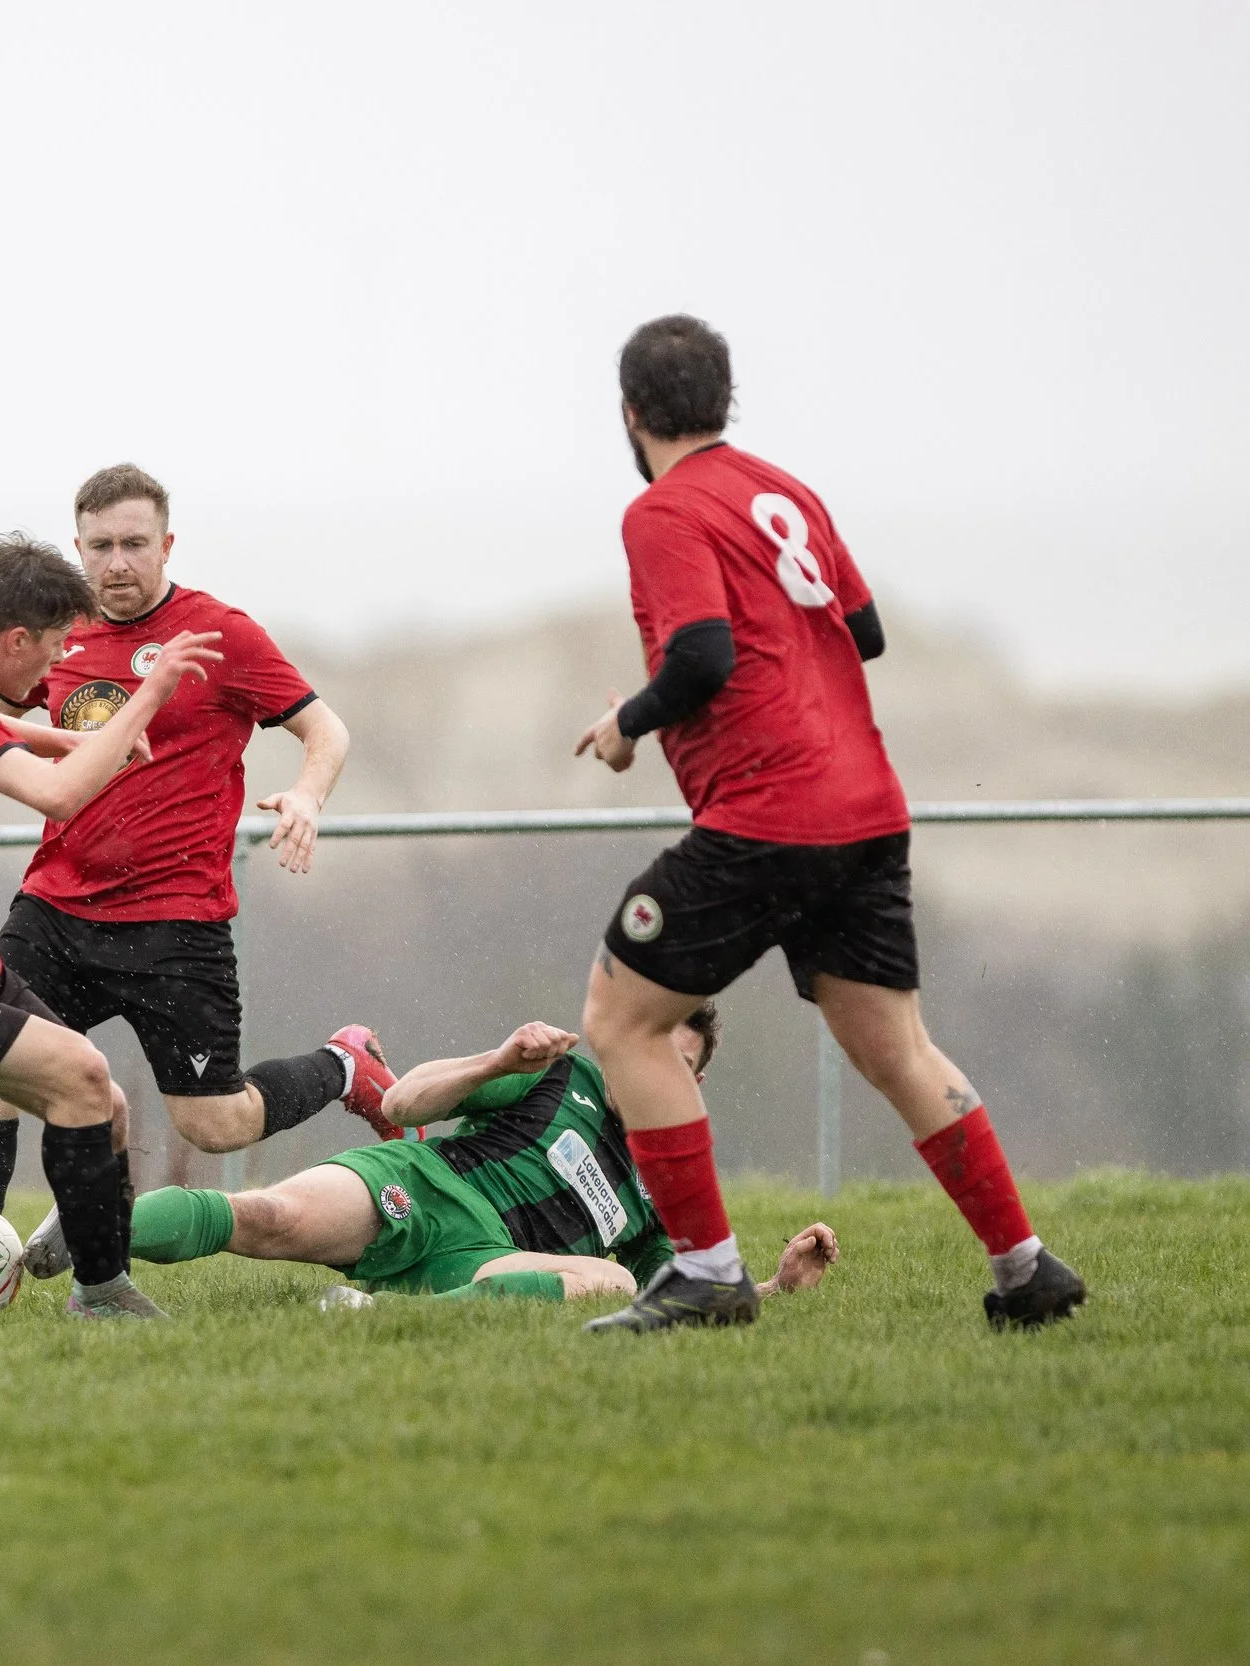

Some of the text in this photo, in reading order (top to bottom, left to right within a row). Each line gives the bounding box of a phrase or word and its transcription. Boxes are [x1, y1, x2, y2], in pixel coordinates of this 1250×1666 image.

[751, 492, 835, 607] 8
[81, 720, 106, 730] CRES
[575, 1164, 617, 1236] Verandahs
[582, 1154, 620, 1215] Lakeland
